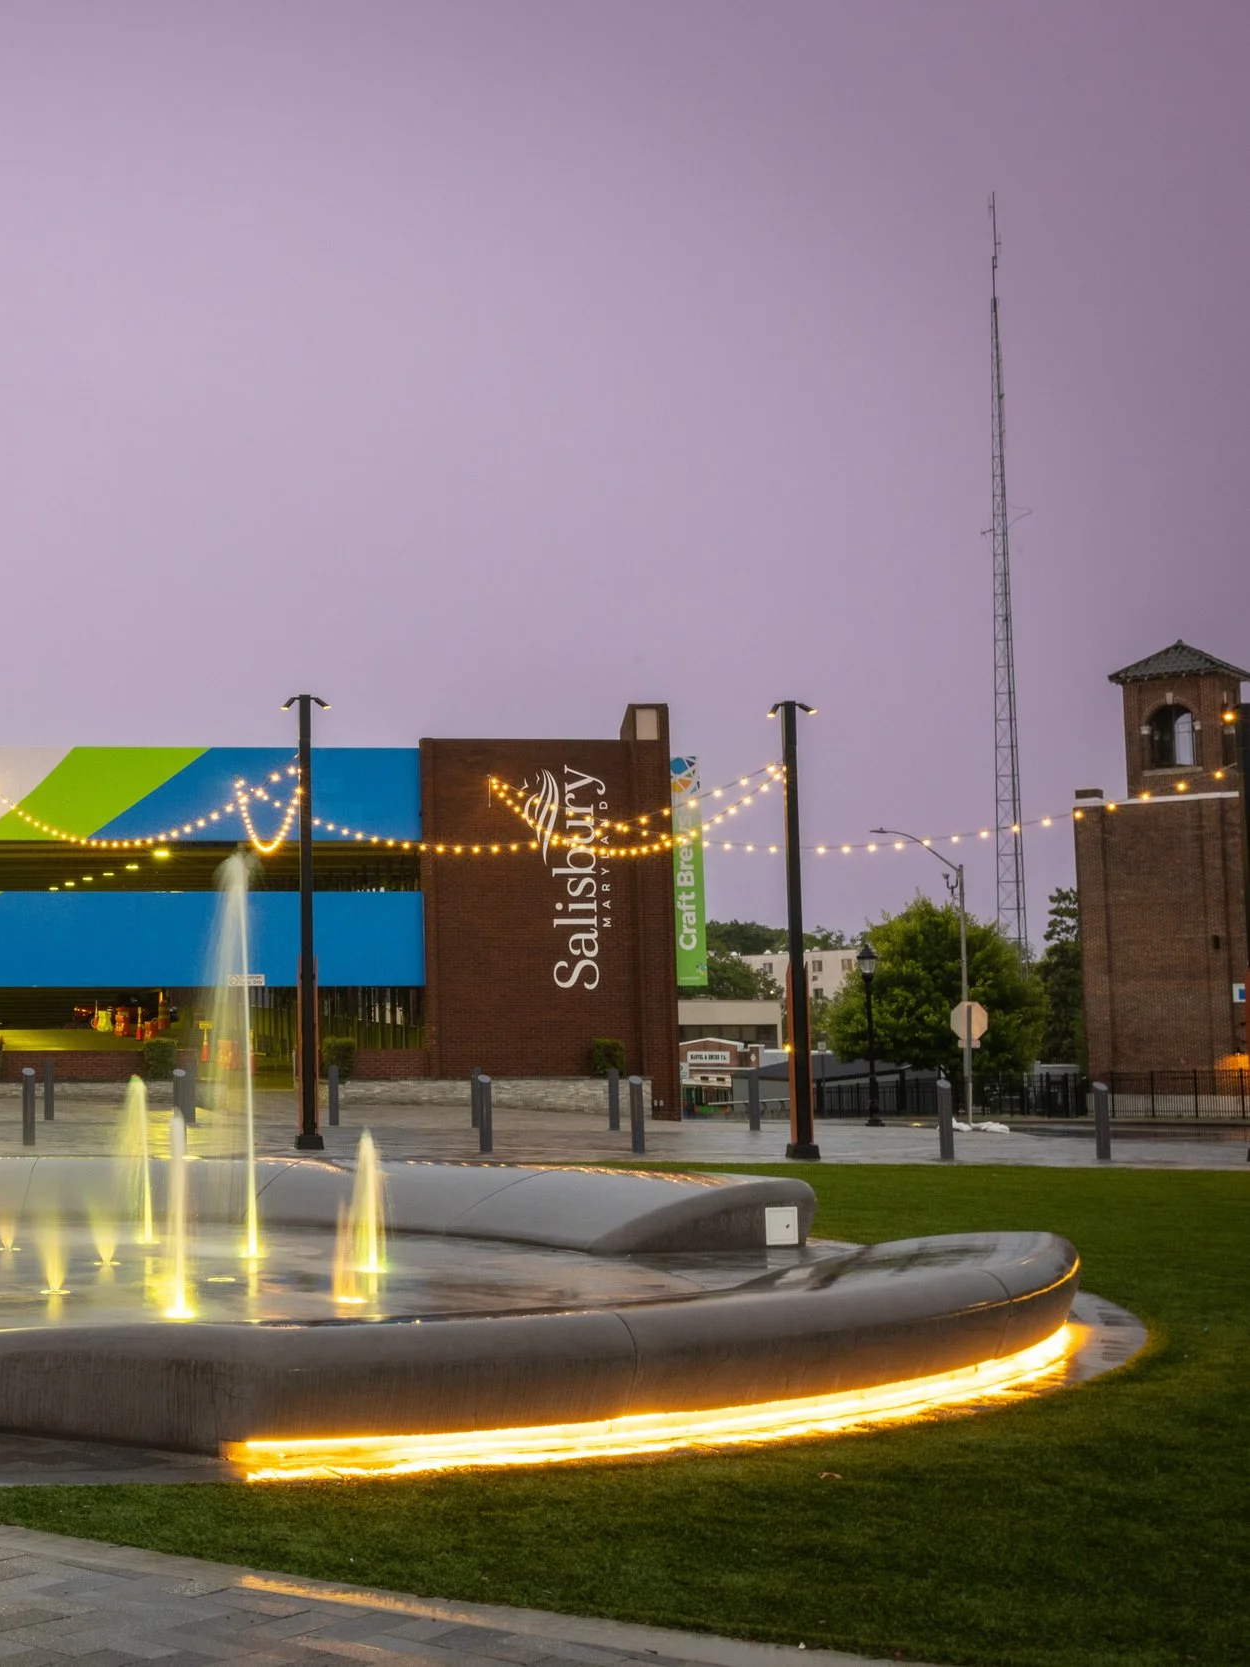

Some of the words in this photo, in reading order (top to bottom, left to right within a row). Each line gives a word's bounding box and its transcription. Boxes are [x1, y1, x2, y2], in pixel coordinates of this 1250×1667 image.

[552, 764, 606, 990] Salisbury
[599, 801, 612, 928] MARYLAND
[676, 891, 698, 951] Craft
